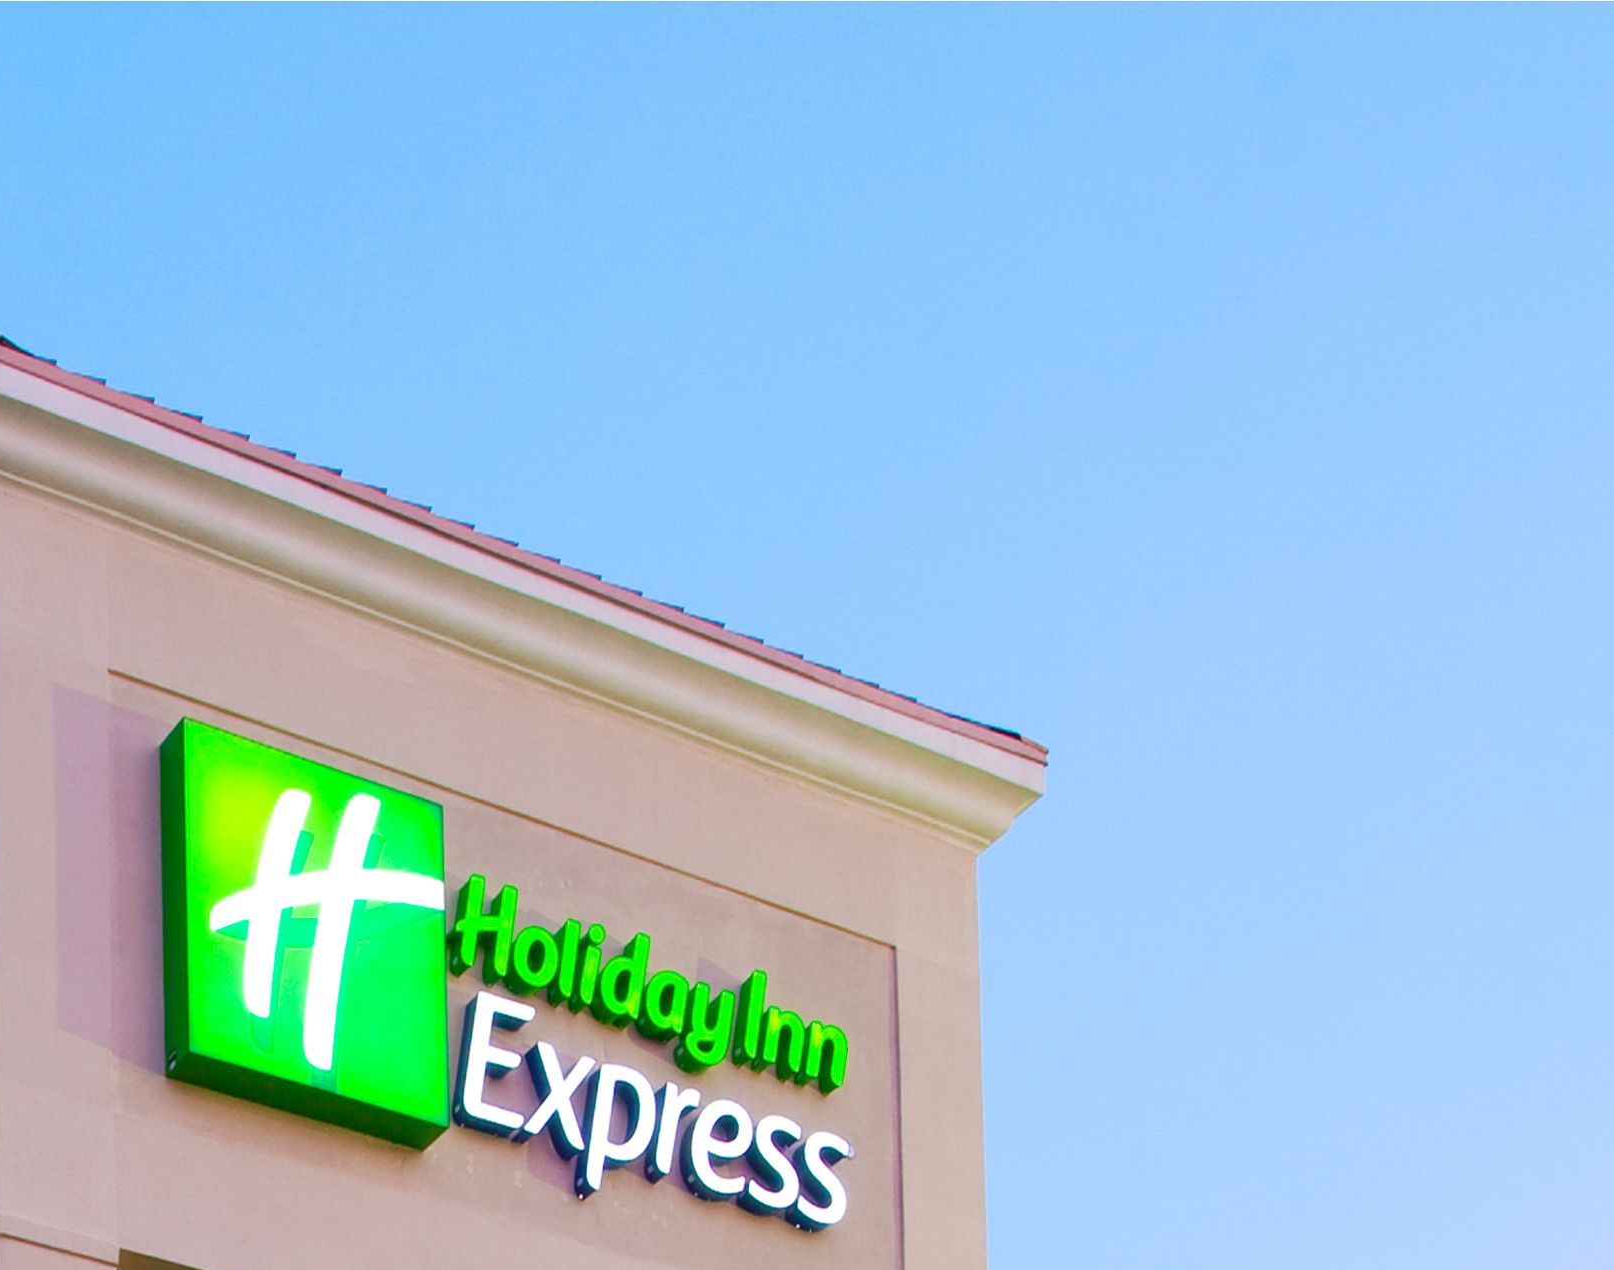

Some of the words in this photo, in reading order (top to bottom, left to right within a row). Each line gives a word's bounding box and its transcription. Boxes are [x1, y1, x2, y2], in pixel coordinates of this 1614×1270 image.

[450, 874, 735, 1072] Holiday
[734, 969, 848, 1093] Inn
[455, 991, 854, 1230] Express
